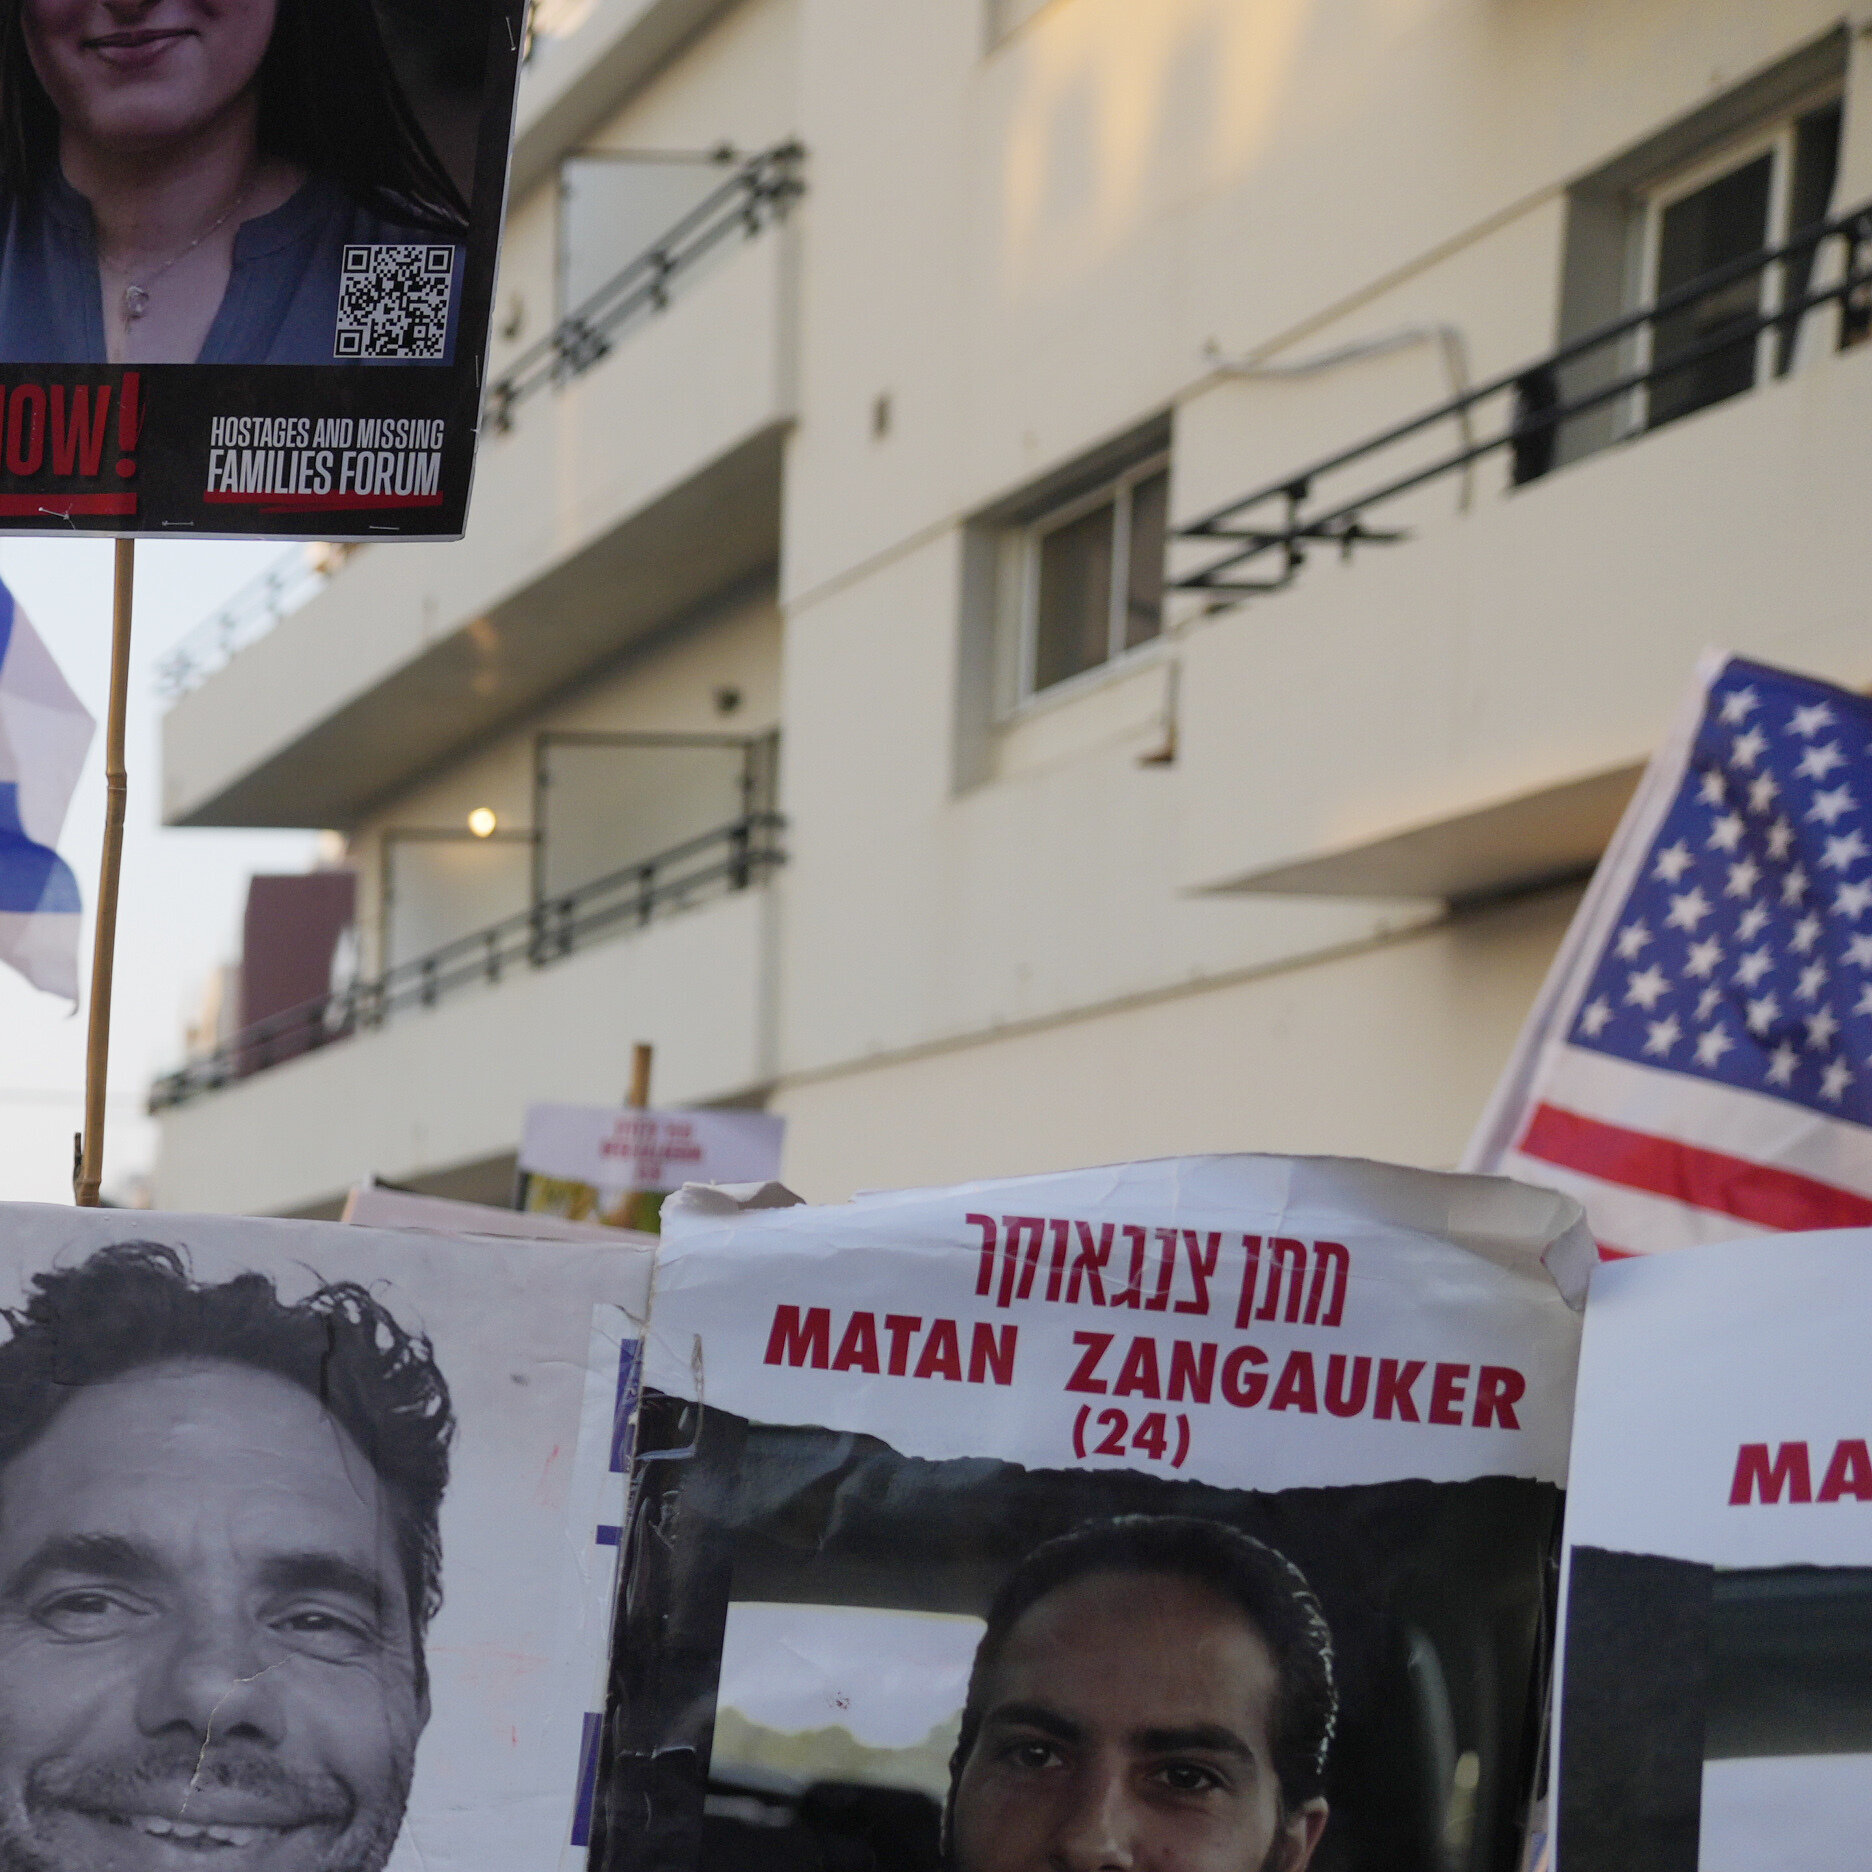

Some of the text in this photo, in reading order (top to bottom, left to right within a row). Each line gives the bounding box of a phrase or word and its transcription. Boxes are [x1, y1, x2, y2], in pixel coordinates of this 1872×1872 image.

[210, 416, 445, 450] HOSTAGES AND MISSING
[207, 449, 442, 496] FAMILIES FORUM
[965, 1212, 1351, 1330] מתן צנגאוקר
[763, 1303, 1527, 1430] MATAN ZANGAUKER
[1072, 1405, 1191, 1469] (24)
[1728, 1438, 1872, 1506] MA
